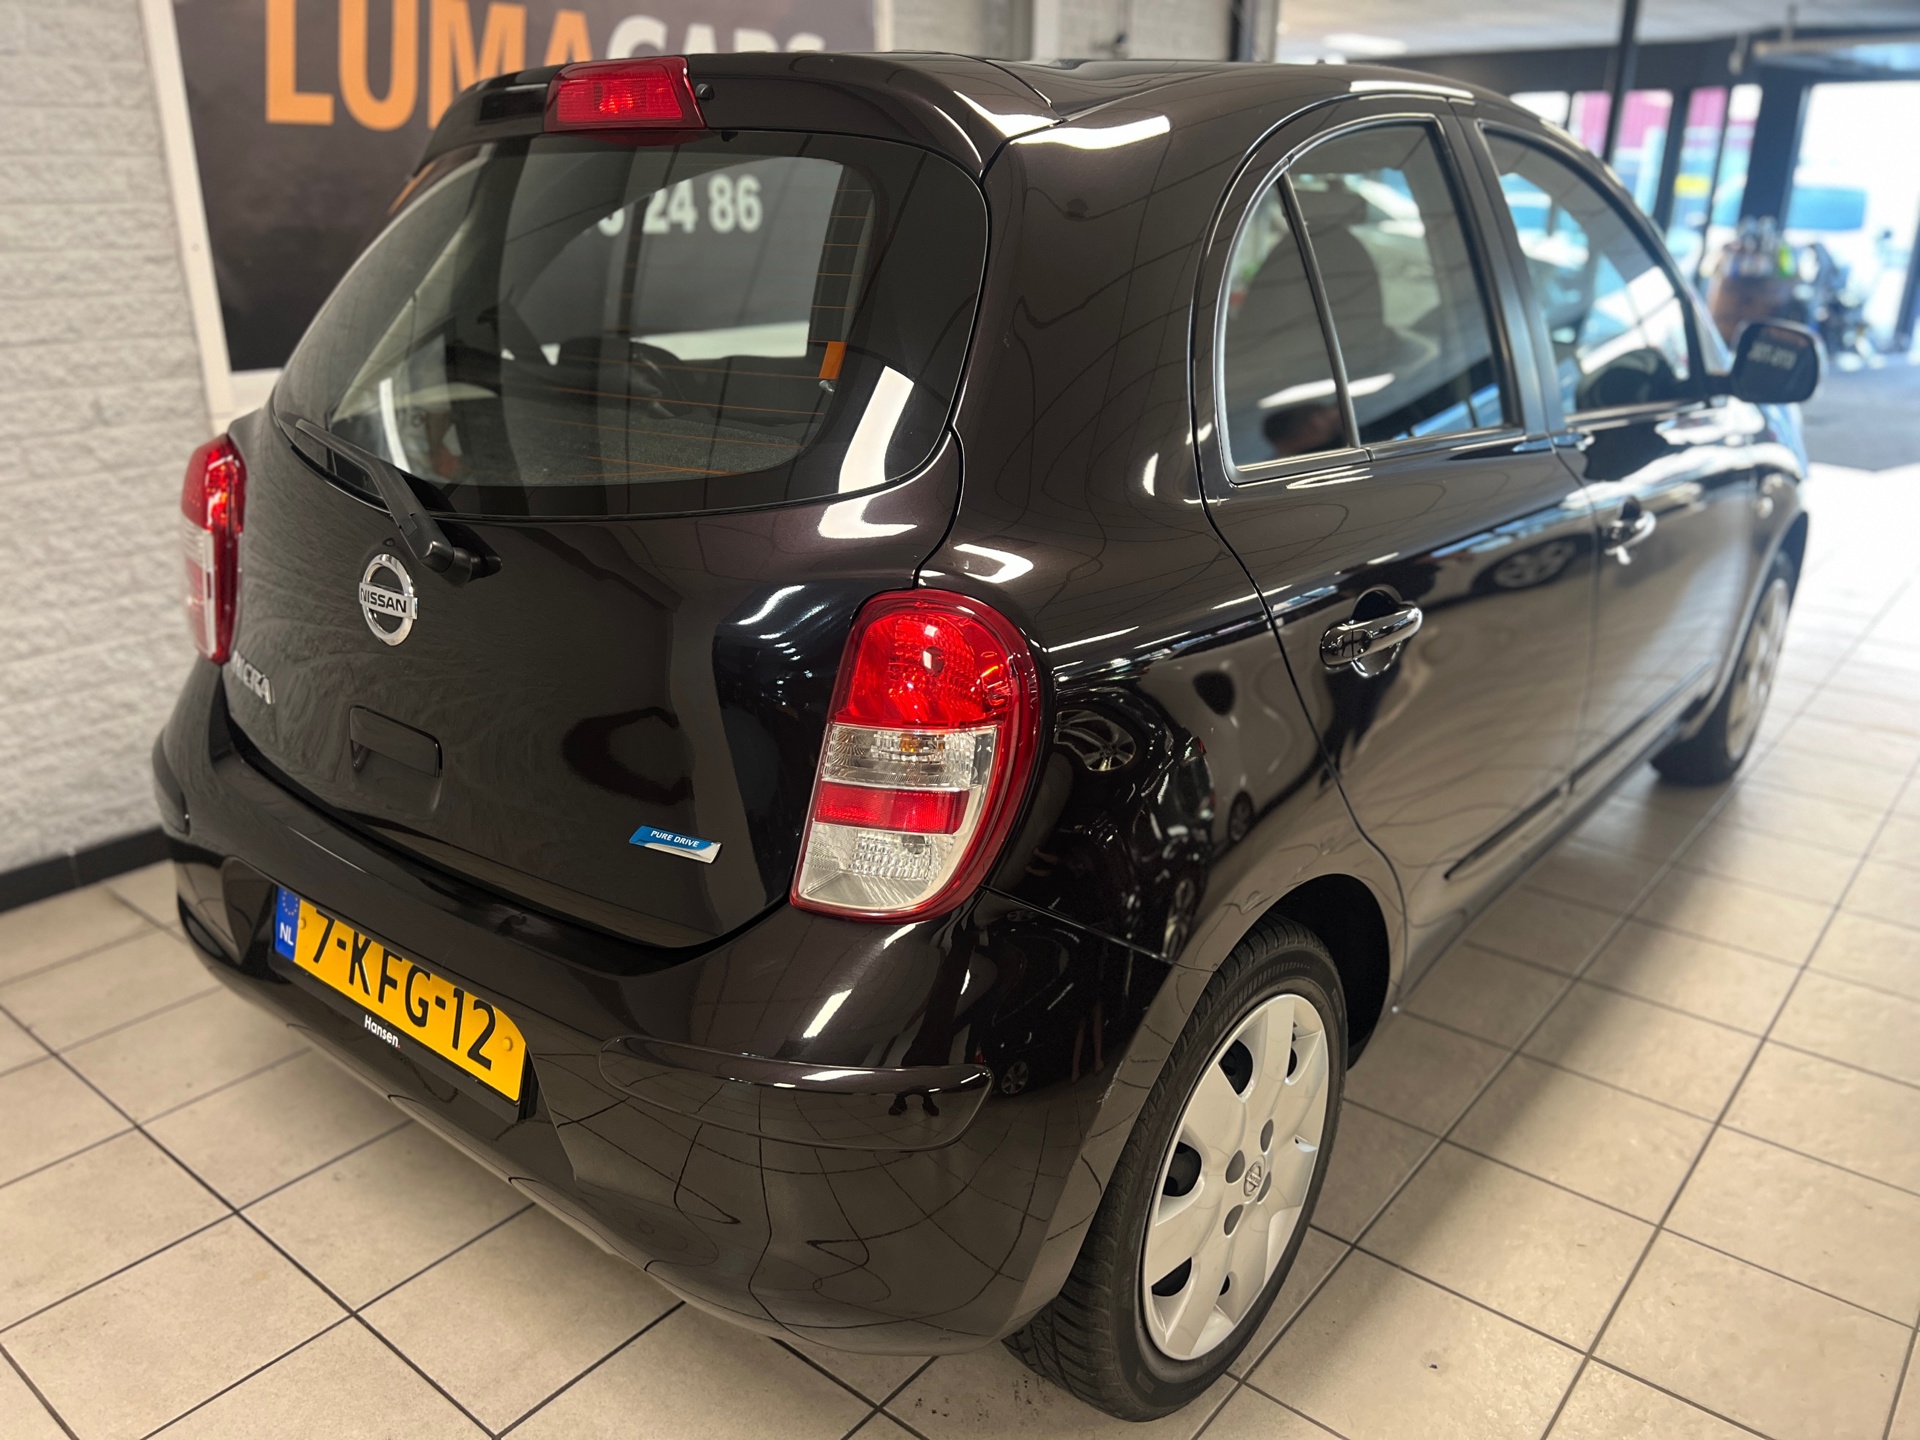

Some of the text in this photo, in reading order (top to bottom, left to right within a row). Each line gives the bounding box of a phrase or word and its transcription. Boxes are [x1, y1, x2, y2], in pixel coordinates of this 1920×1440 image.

[643, 178, 698, 234] 24
[709, 174, 763, 234] 86
[360, 587, 407, 614] NISSAN
[650, 830, 700, 848] PURE DRIVE
[280, 921, 294, 946] NL
[313, 908, 497, 1071] 7-KFG-12
